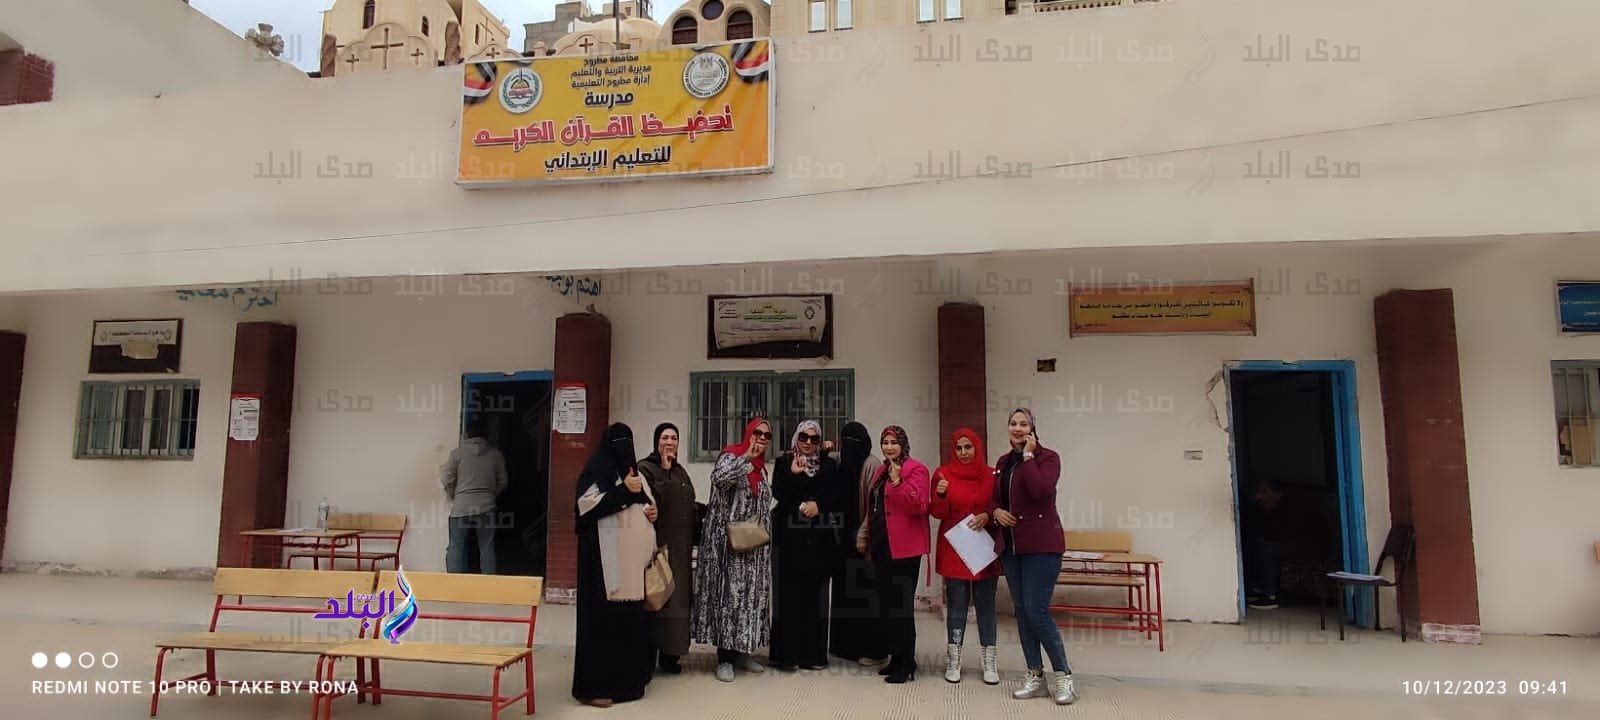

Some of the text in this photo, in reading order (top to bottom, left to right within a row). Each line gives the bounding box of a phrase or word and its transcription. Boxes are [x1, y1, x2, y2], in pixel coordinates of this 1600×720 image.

[584, 56, 608, 66] مطروح
[571, 65, 652, 79] مديرية التربية والتعليم
[571, 74, 651, 90] إدارة مطروح التعليمية
[584, 91, 634, 110] مدرسة
[473, 119, 556, 152] الكريم
[560, 113, 636, 147] القرآن
[544, 145, 671, 174] للتعليم الإبتدائي
